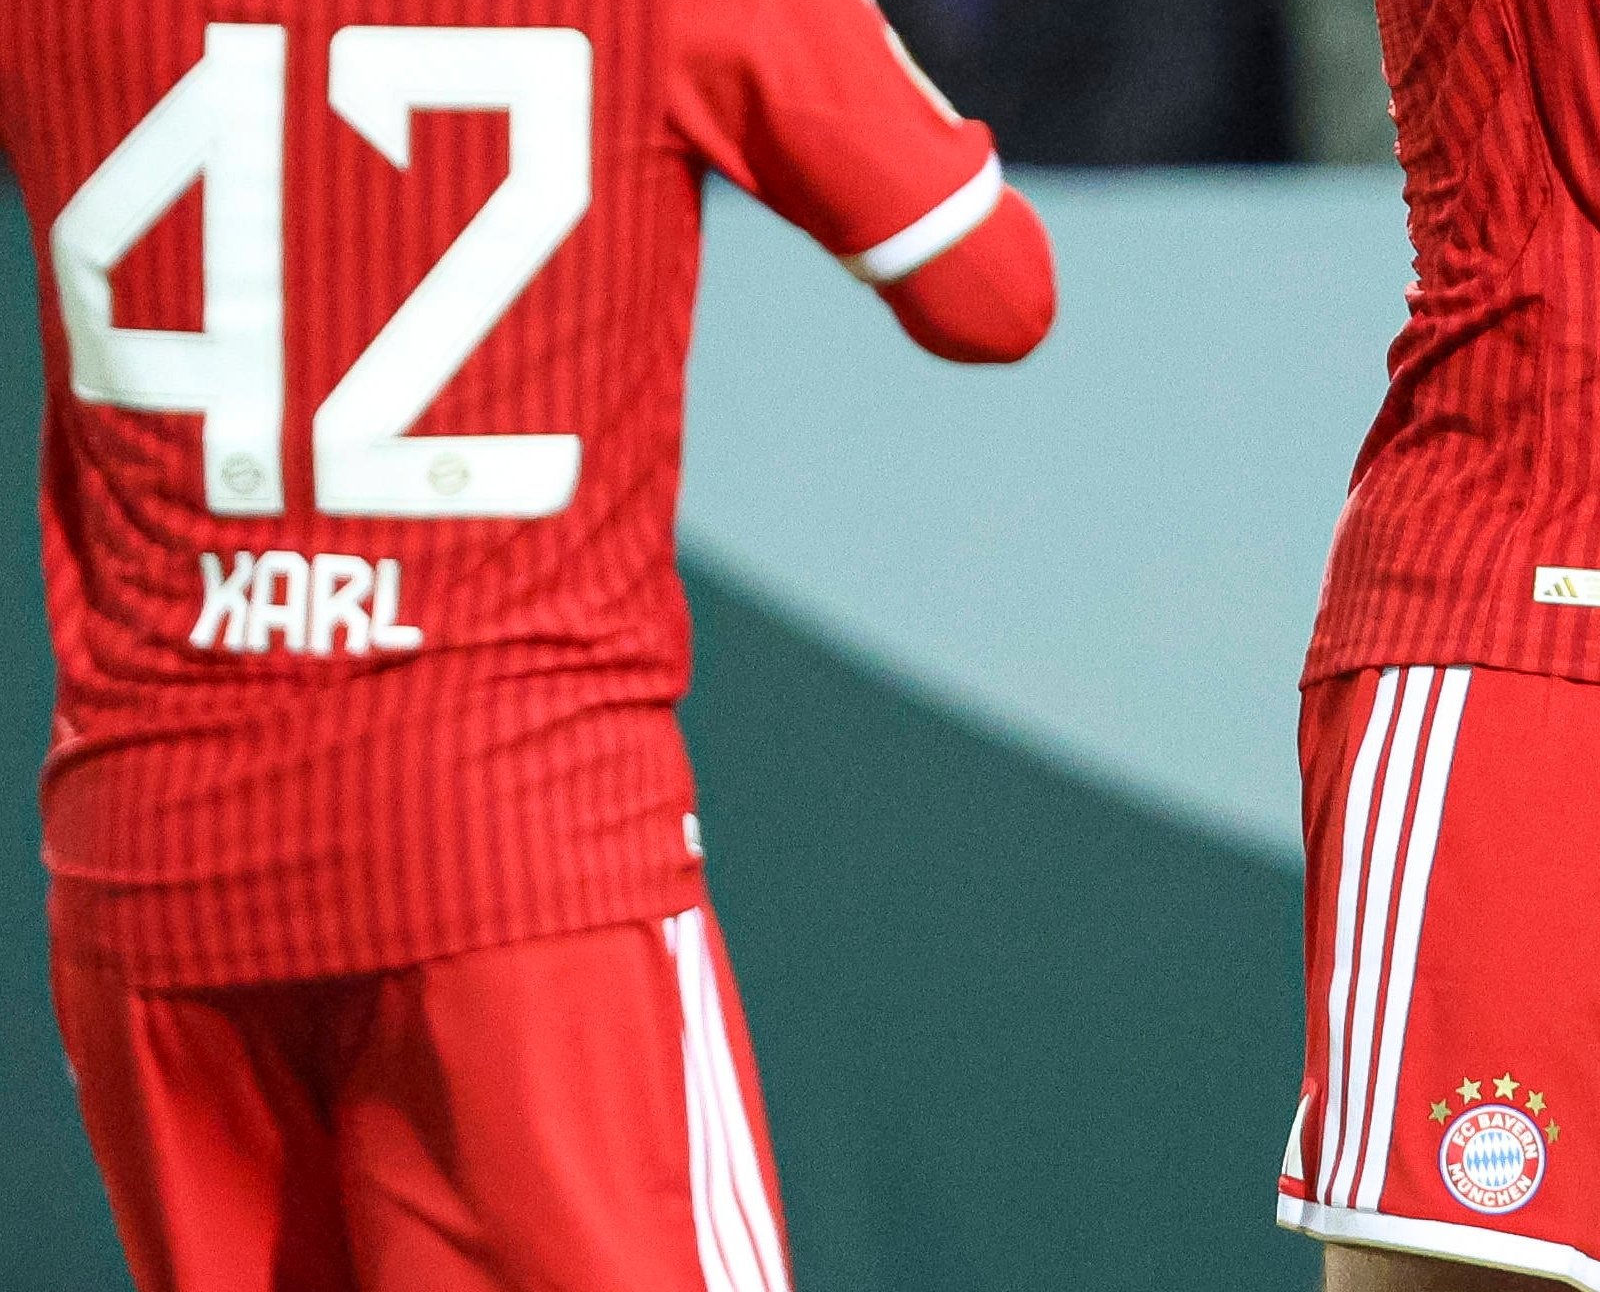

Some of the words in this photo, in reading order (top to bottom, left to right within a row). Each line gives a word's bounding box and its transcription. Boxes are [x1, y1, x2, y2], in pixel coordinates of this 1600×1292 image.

[51, 21, 593, 519] 42
[189, 550, 424, 657] KARL
[1452, 1121, 1476, 1147] FC
[1477, 1112, 1539, 1160] BAYERN
